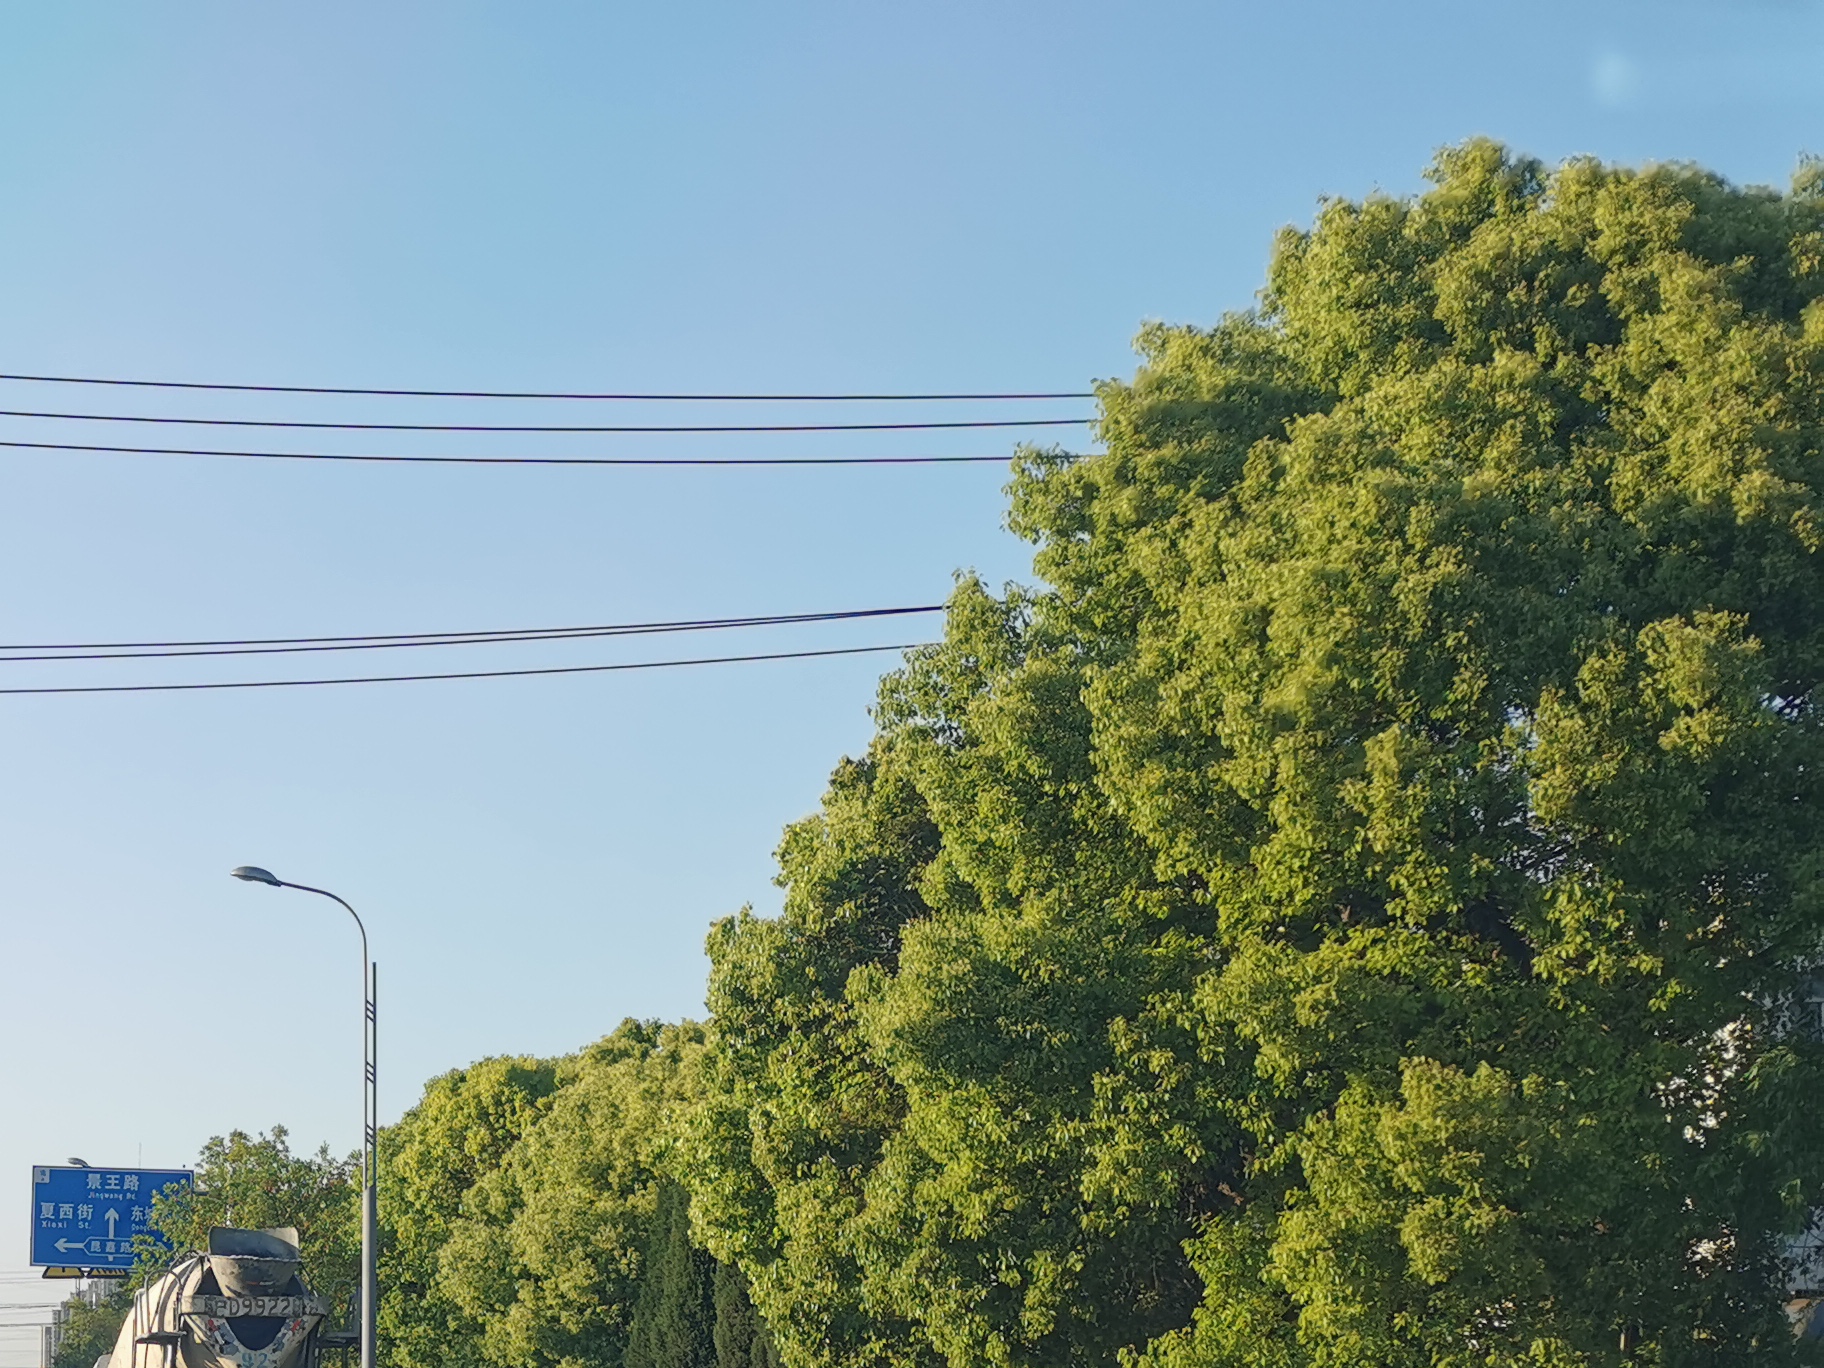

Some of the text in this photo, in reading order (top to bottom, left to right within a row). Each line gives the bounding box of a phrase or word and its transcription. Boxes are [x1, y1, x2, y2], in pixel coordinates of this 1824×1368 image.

[86, 1173, 140, 1191] 景王路
[40, 1202, 94, 1220] 夏西街
[41, 1220, 67, 1228] Xiaxi
